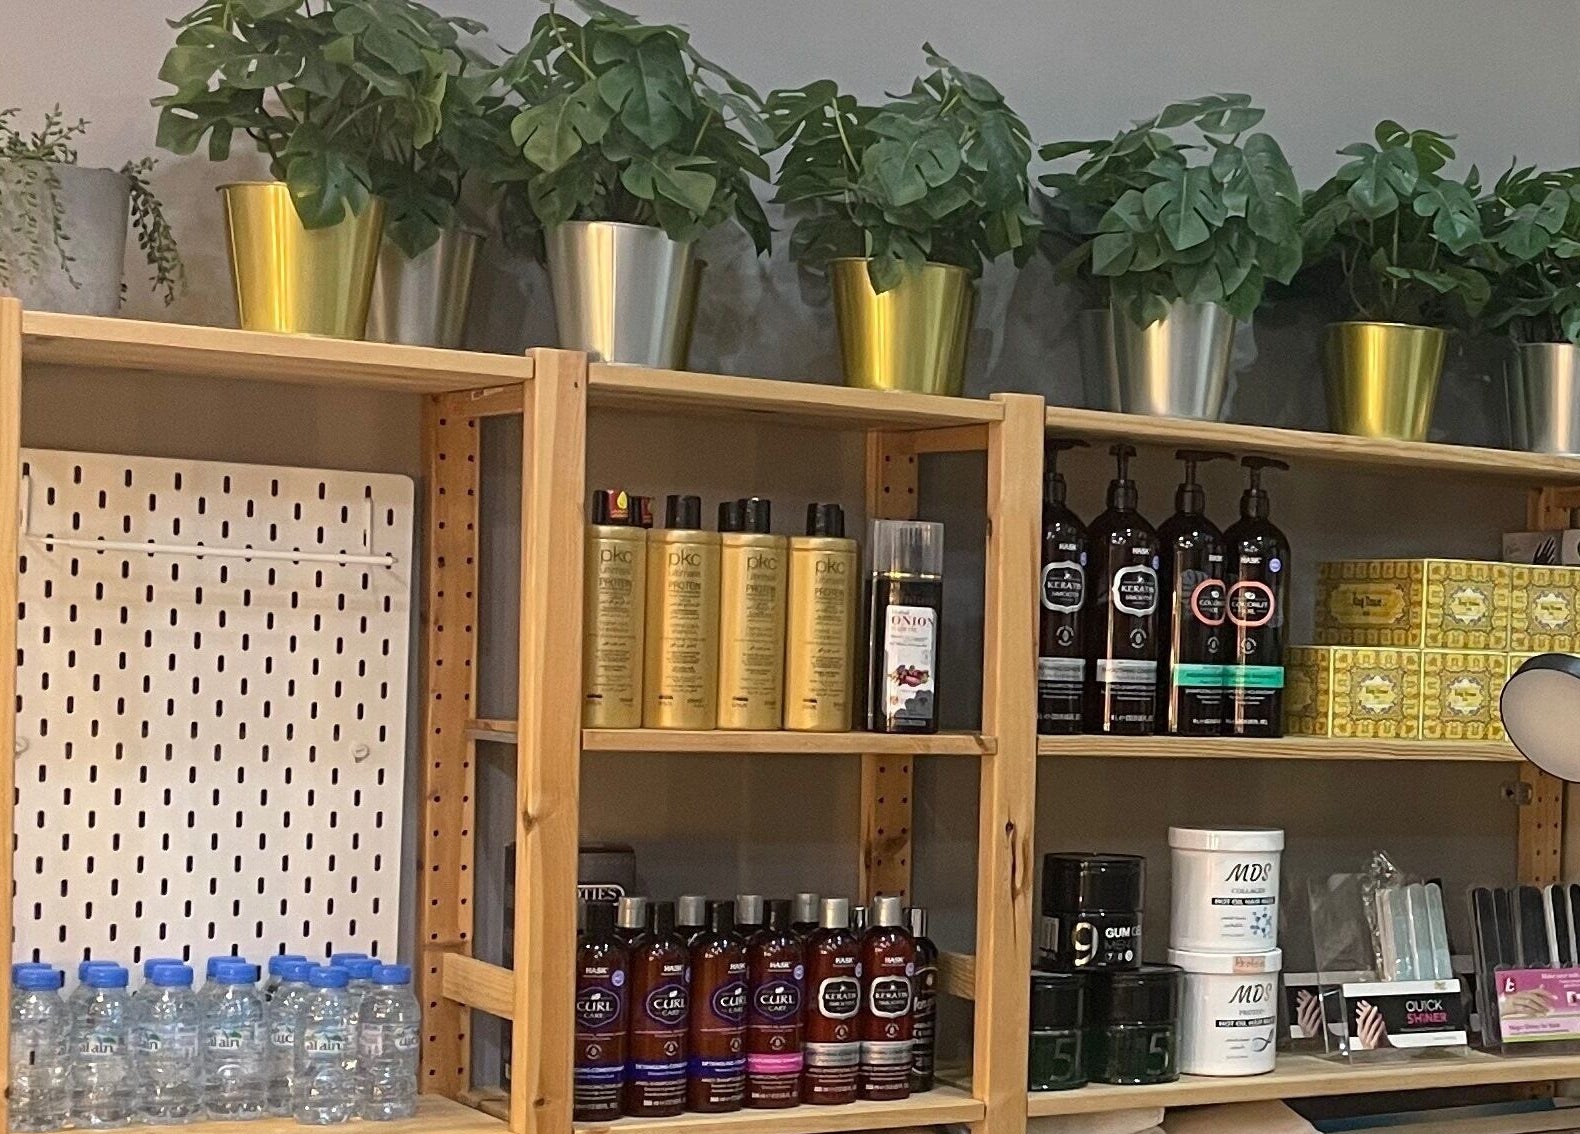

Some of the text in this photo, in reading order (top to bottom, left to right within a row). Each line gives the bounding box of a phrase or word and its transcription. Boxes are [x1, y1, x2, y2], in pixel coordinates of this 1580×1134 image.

[1225, 863, 1272, 882] MDS
[1105, 927, 1130, 938] GUM
[1228, 982, 1273, 1004] MDS
[760, 994, 795, 1005] CURL
[1405, 999, 1443, 1012] QUICK
[576, 1001, 613, 1012] CURL
[1407, 1012, 1447, 1024] SHINER
